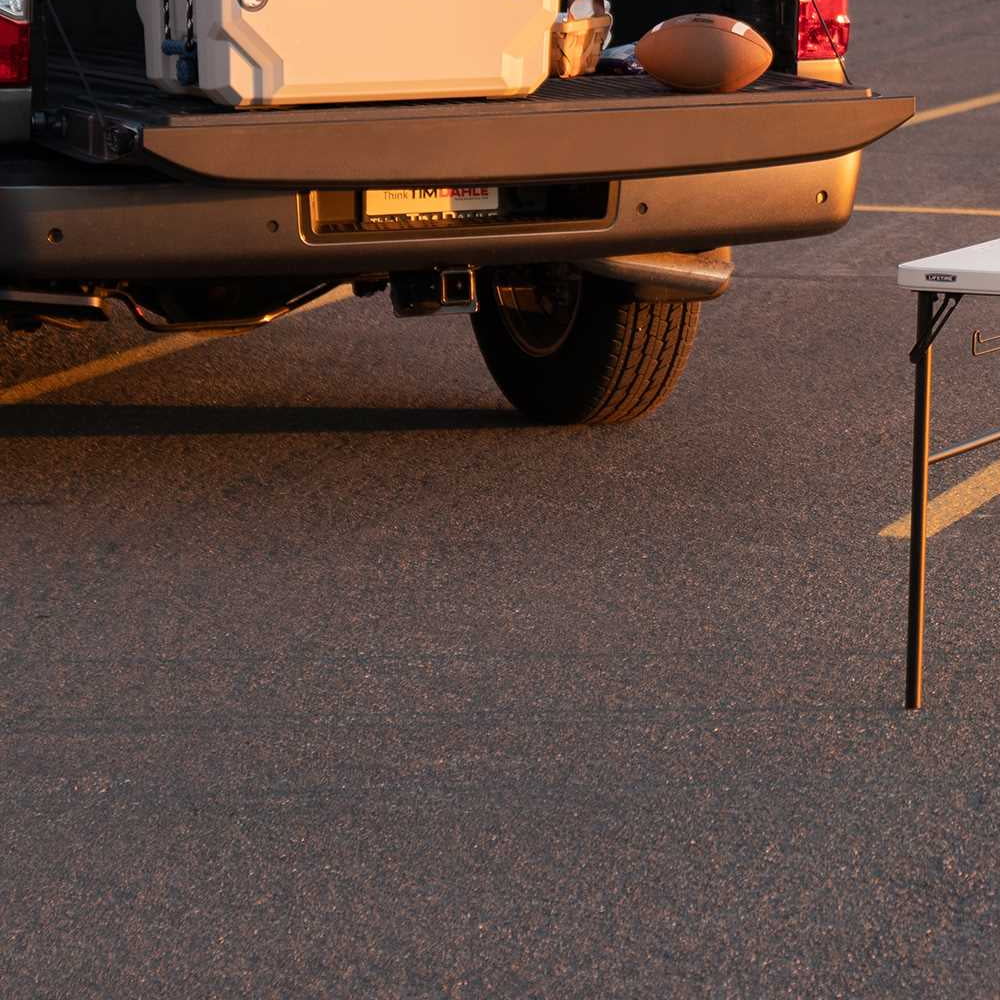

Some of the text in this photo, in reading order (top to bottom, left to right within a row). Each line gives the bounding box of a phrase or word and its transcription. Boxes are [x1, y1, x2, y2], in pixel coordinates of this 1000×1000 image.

[384, 188, 489, 201] Think TIM DAHLE
